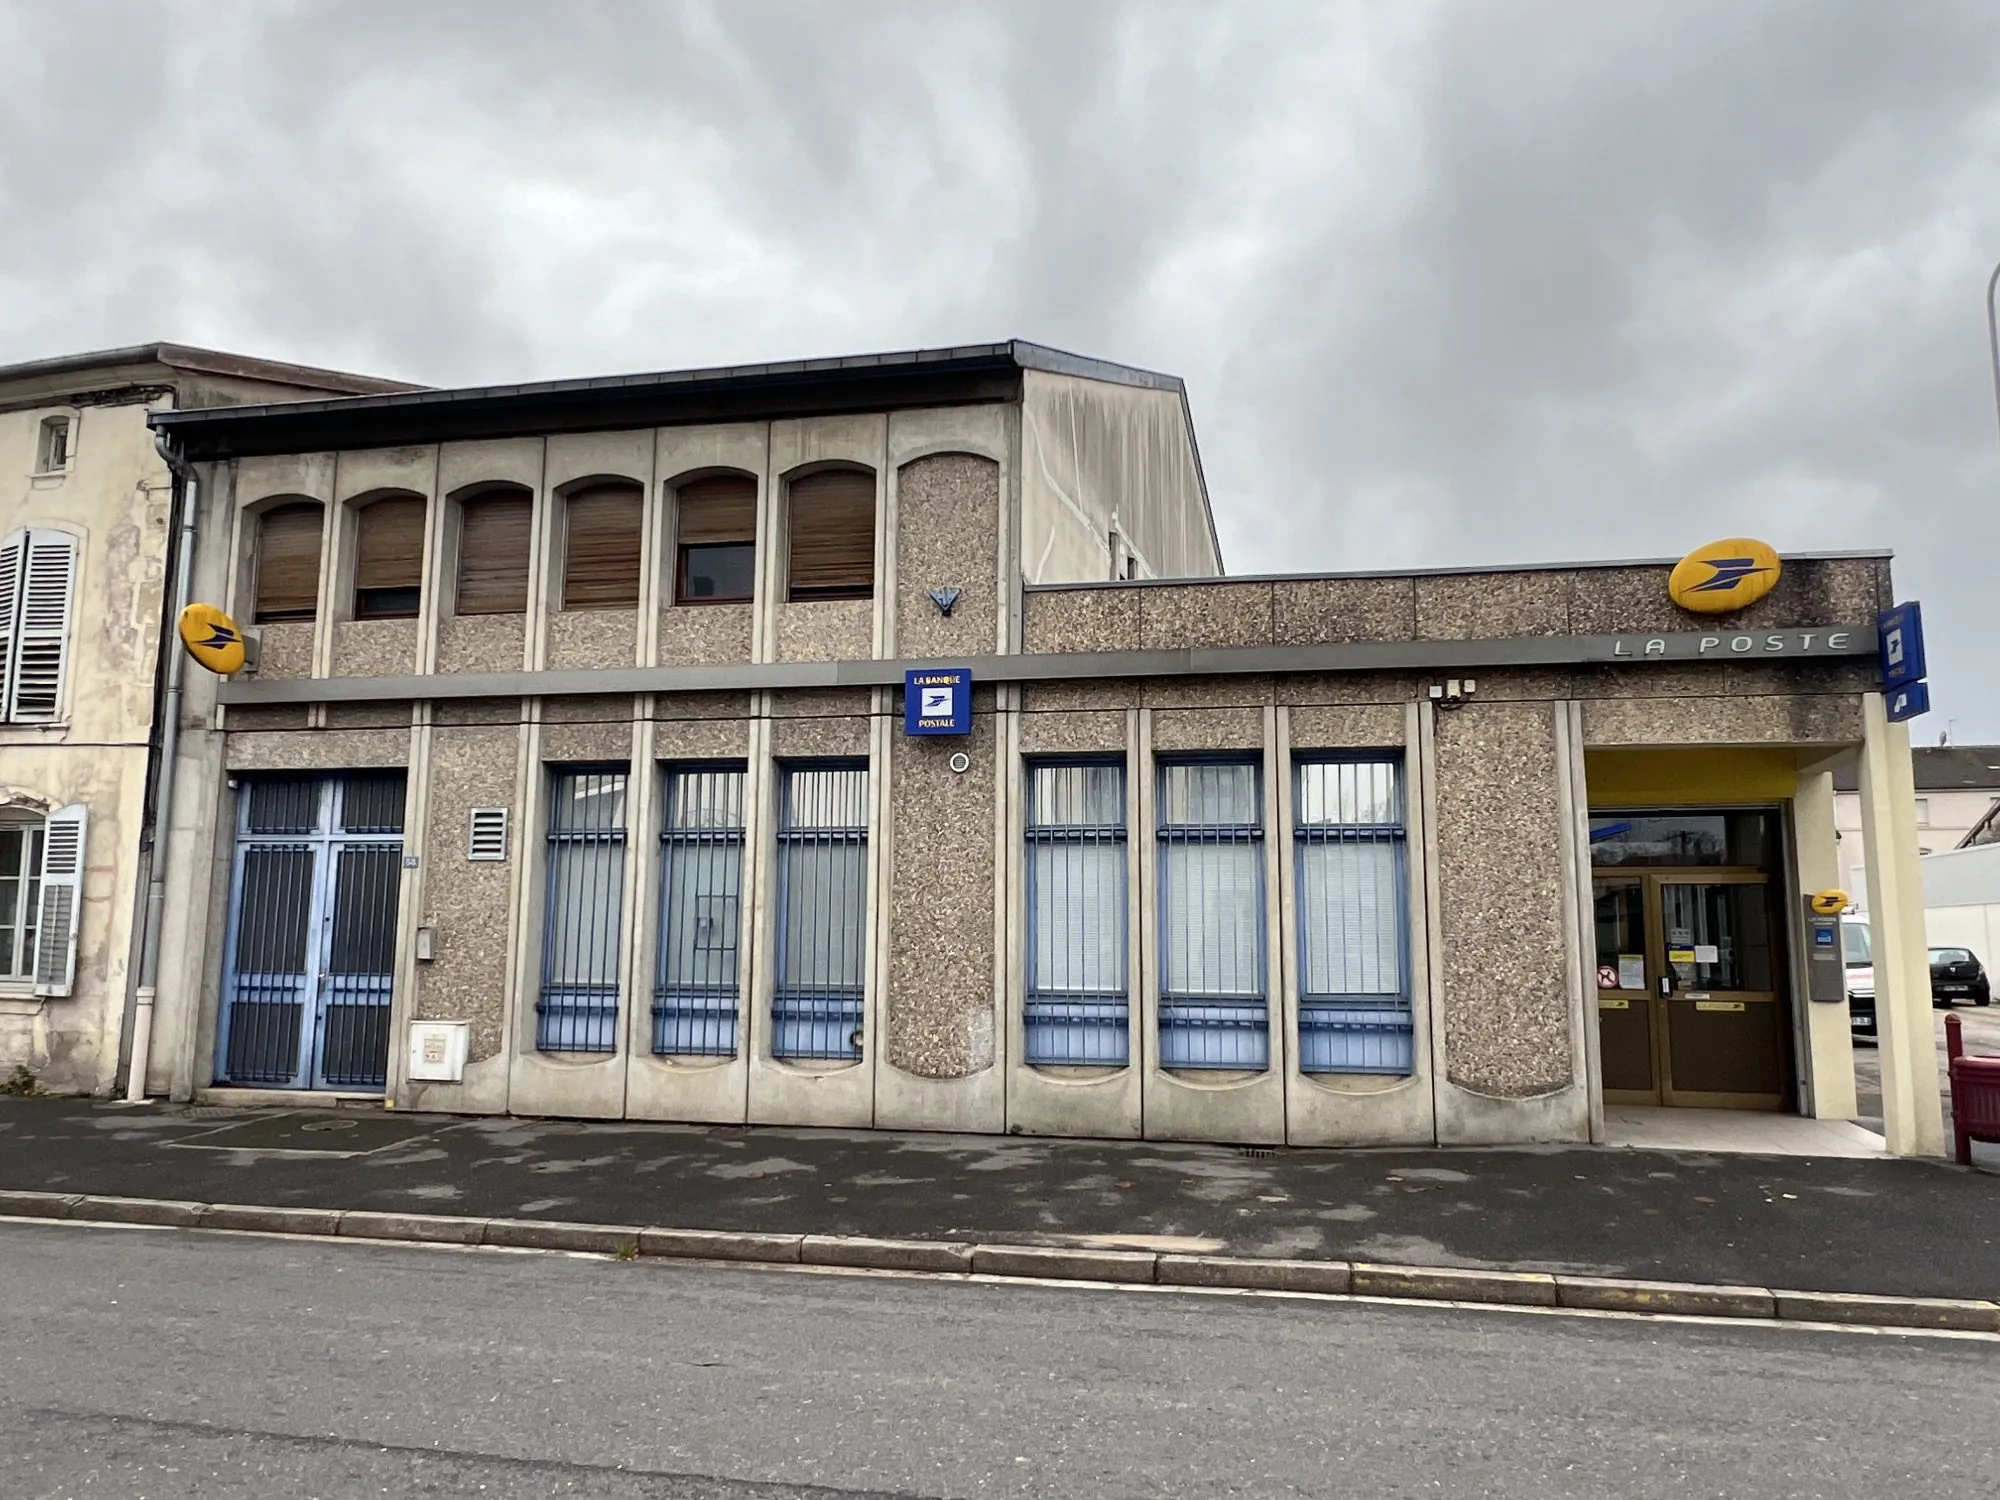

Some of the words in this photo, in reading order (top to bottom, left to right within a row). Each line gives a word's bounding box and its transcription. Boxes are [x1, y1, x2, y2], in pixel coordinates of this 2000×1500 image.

[1613, 638, 1665, 657] LA
[1698, 632, 1851, 654] POSTE
[914, 677, 925, 685] LA
[925, 675, 961, 685] BANQUE
[918, 719, 955, 727] POSTALE
